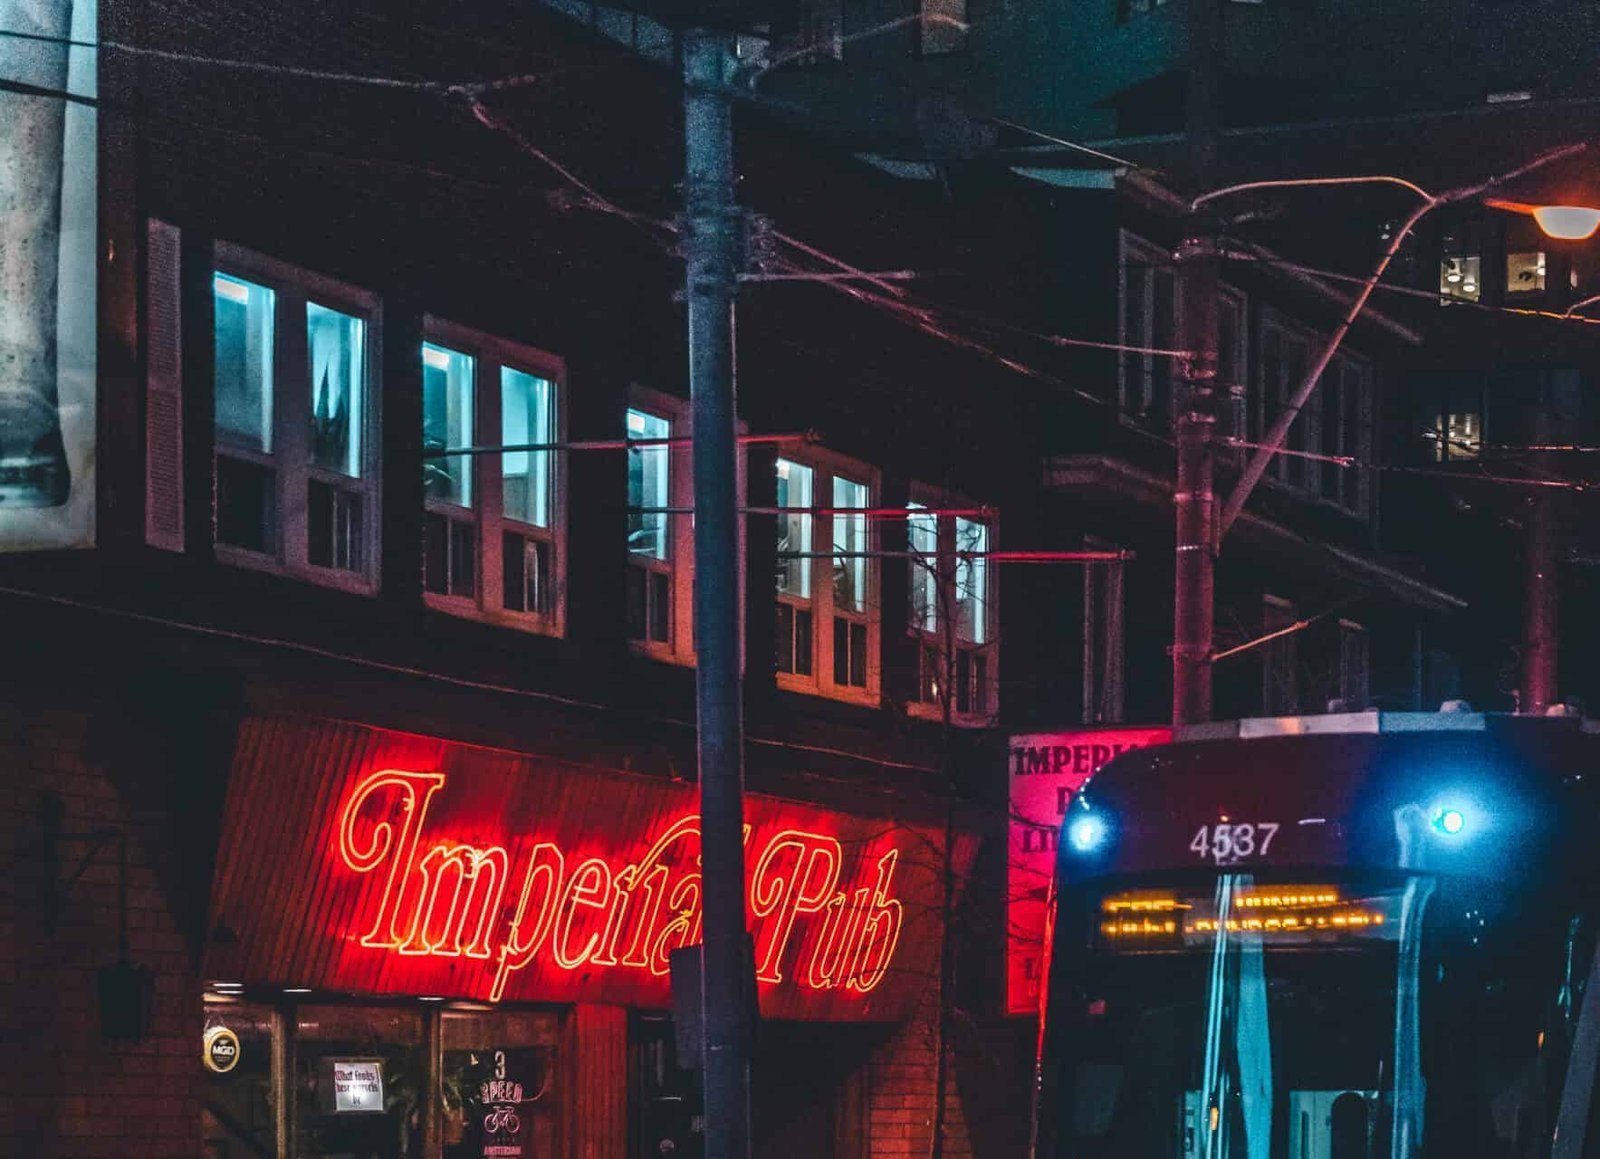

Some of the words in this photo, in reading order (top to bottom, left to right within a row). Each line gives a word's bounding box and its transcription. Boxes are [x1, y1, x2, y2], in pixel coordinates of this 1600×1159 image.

[1189, 823, 1280, 858] 4537
[340, 769, 750, 1002] Imperia
[752, 830, 903, 993] Pub
[213, 1045, 235, 1056] MGD
[495, 1051, 506, 1080] 3
[482, 1081, 523, 1104] SPEED
